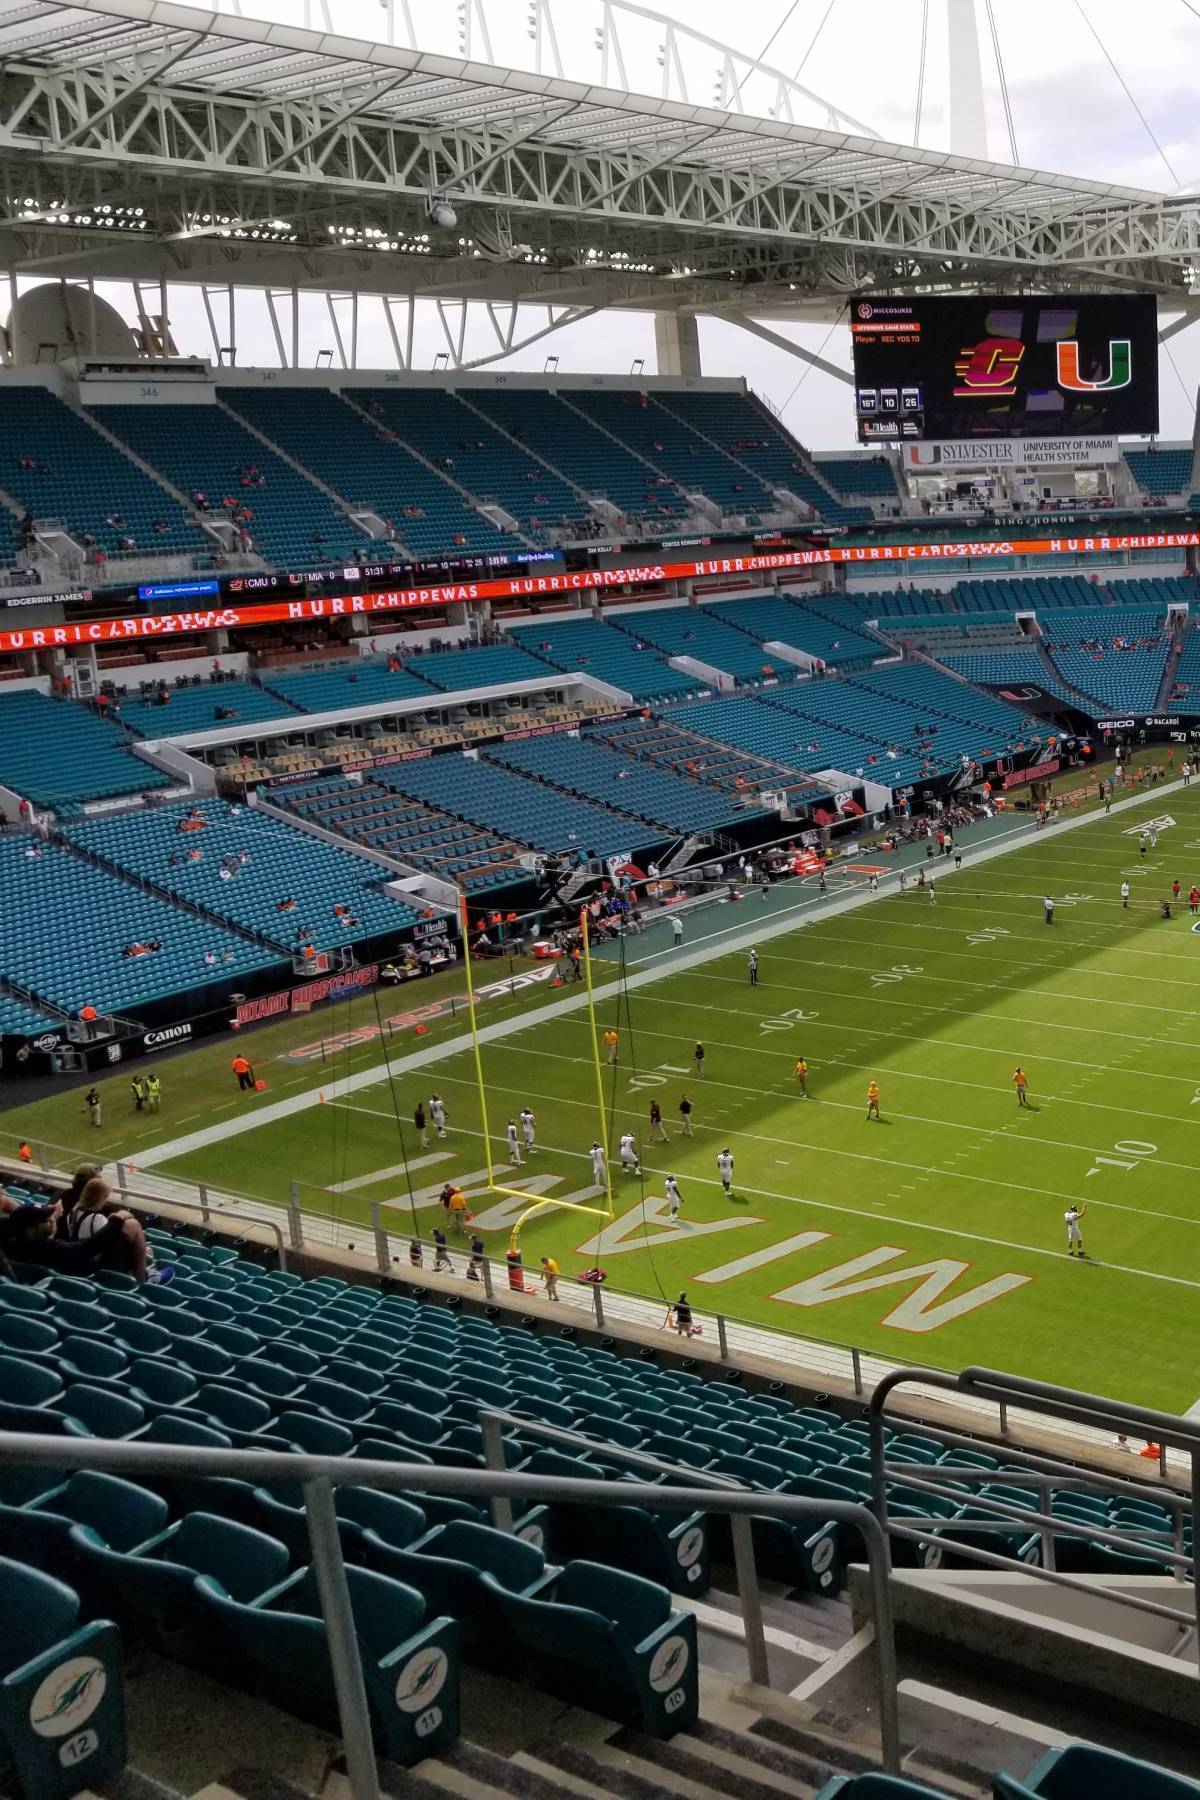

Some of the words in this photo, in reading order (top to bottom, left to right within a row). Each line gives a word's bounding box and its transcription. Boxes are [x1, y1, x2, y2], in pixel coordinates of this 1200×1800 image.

[261, 372, 276, 381] 347
[140, 387, 158, 397] 346
[861, 399, 875, 408] 1ST
[885, 398, 895, 408] 10
[943, 443, 1012, 460] SYLVESTER
[1023, 441, 1070, 452] UNIVERSITY
[1072, 440, 1084, 450] OF
[1086, 439, 1113, 449] MIAMI
[1024, 452, 1055, 462] HEALTH
[1057, 451, 1089, 461] SYSTEM
[994, 518, 1024, 527] RING
[1034, 516, 1075, 525] HONOR
[441, 561, 449, 570] 10
[475, 558, 483, 566] 25
[308, 572, 323, 582] MIA
[365, 567, 384, 576] 51:31
[248, 577, 267, 588] CMU
[7, 595, 52, 607] EDGERRIN
[53, 592, 84, 603] JAMES
[1097, 720, 1134, 729] GEICO
[875, 963, 926, 985] 30
[236, 991, 290, 1025] MIAMI
[291, 964, 379, 1006] HURRICANES
[761, 1007, 820, 1031] 20
[143, 1023, 192, 1045] Canon
[630, 1062, 692, 1091] 10
[1085, 1139, 1159, 1178] 10
[322, 1150, 1035, 1334] MIAMI
[666, 1691, 684, 1710] 10
[418, 1716, 438, 1736] 11
[64, 1739, 93, 1762] 12
